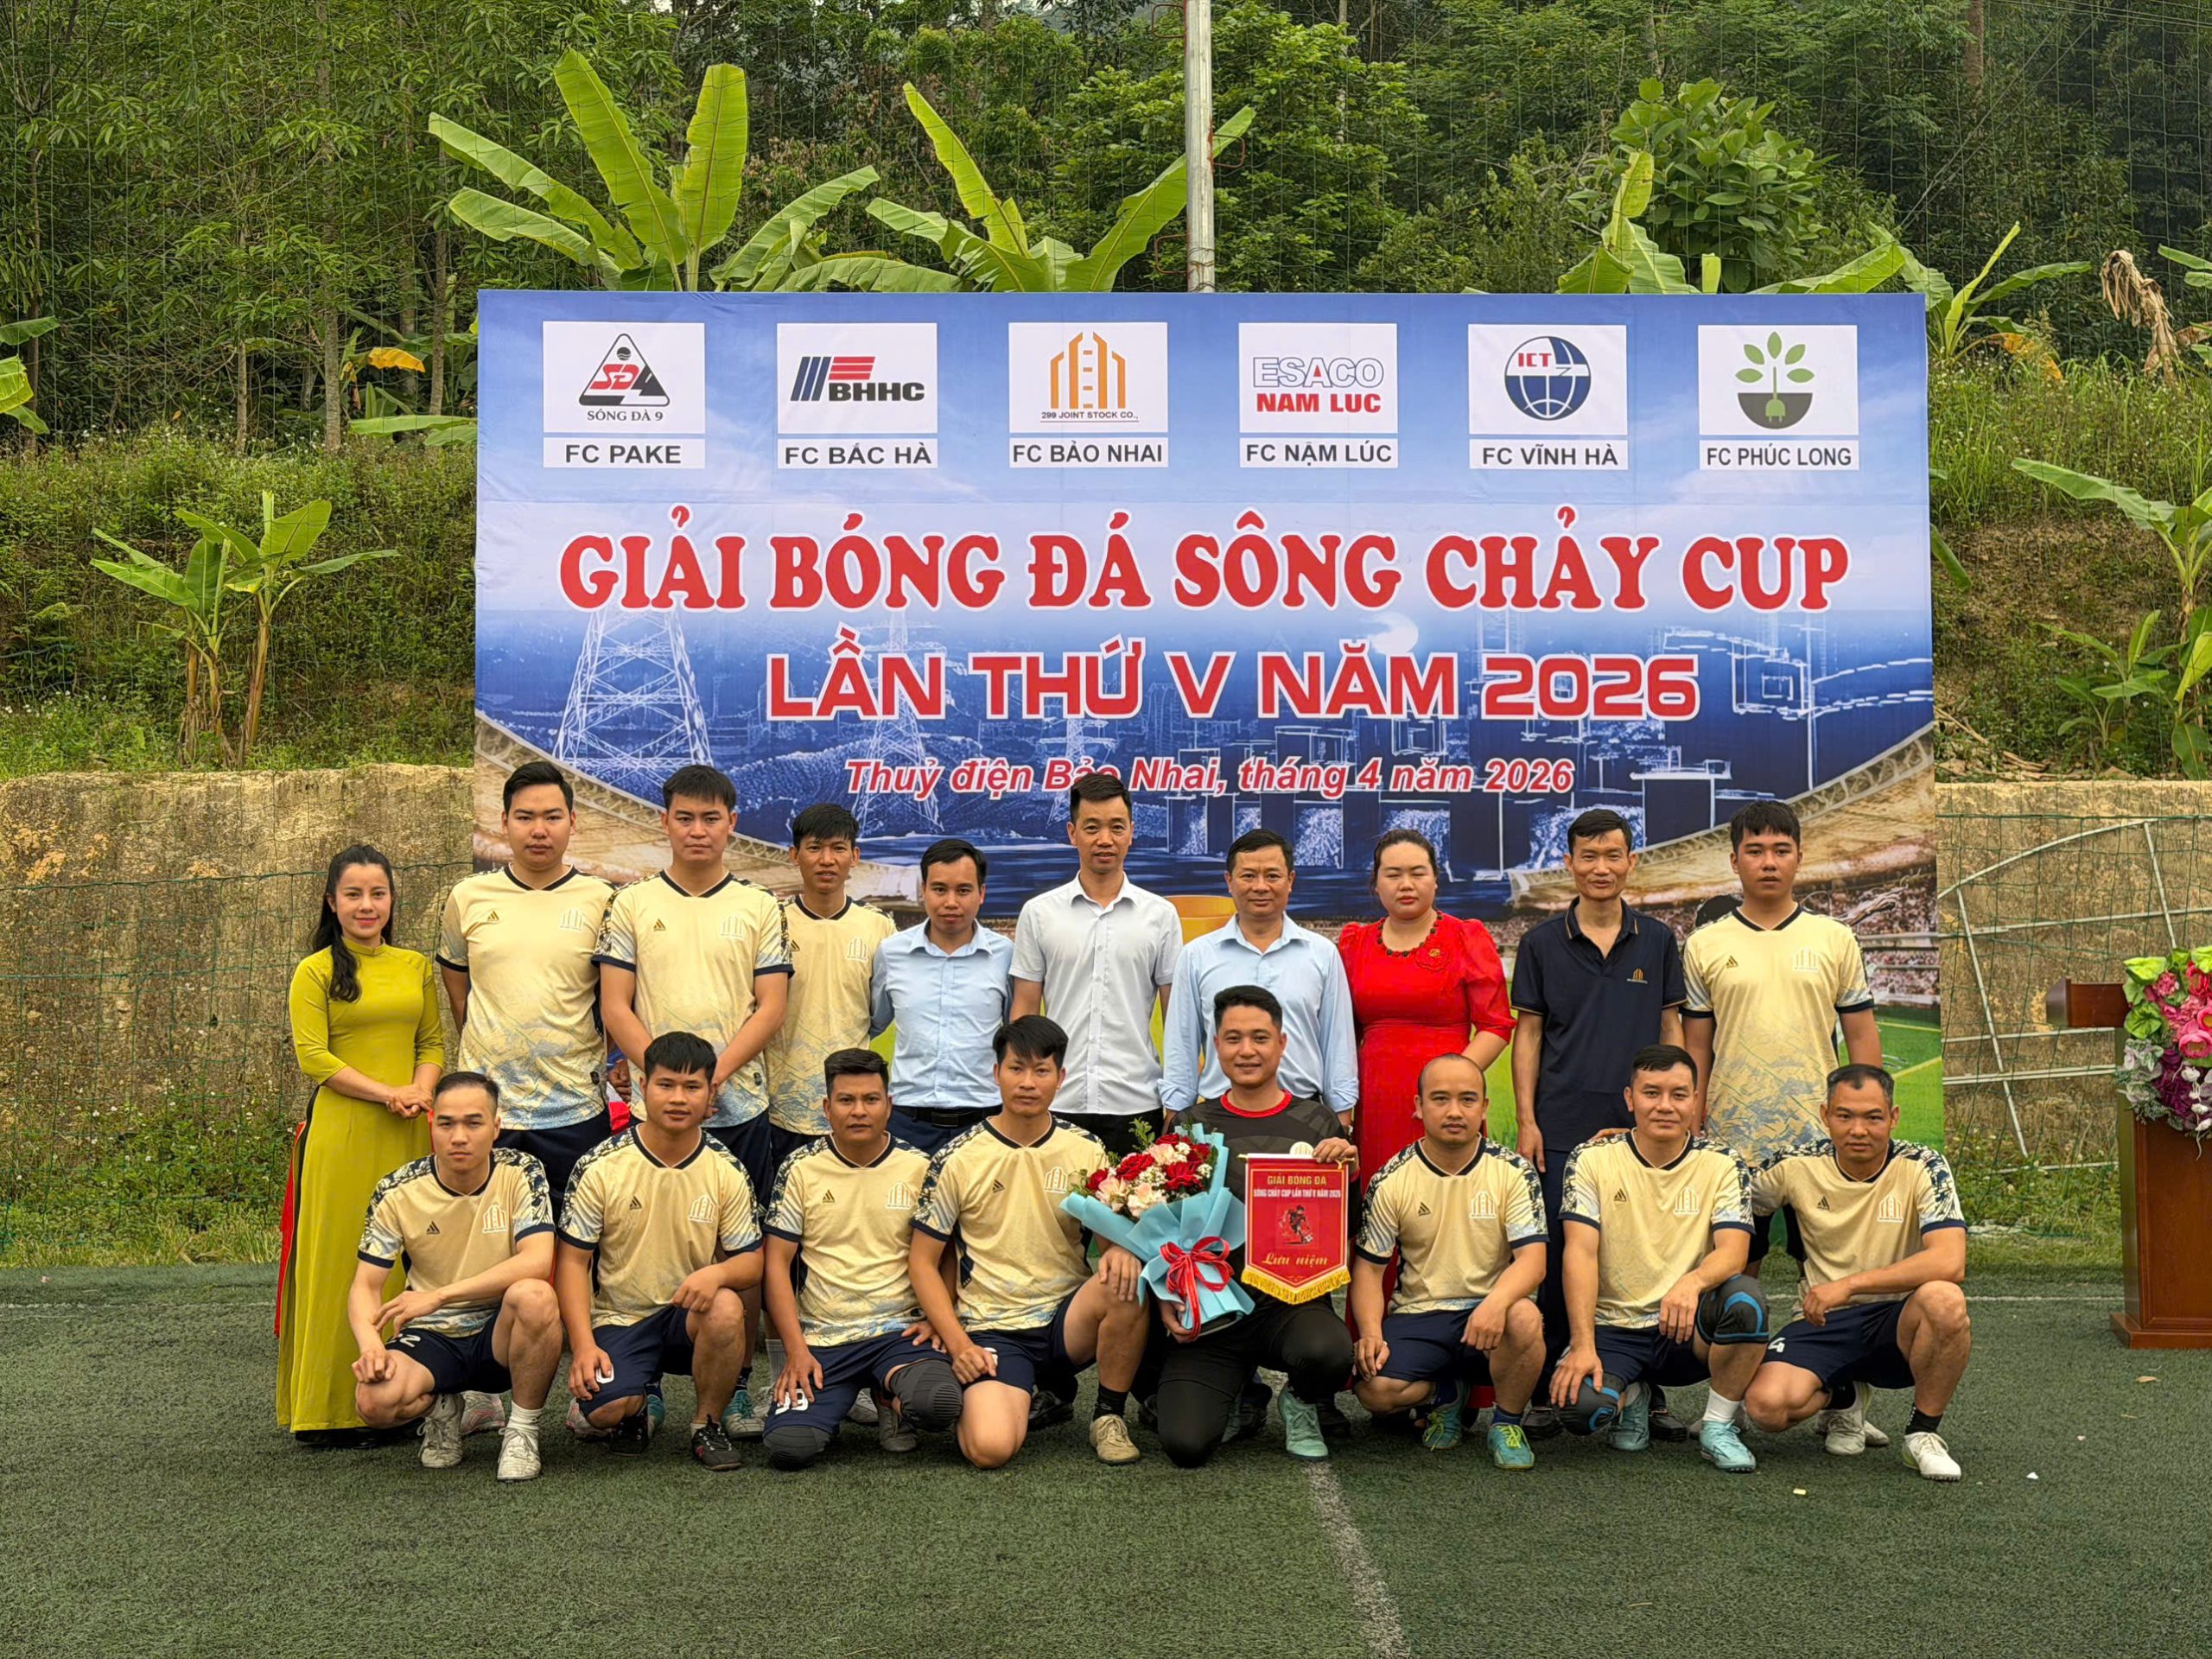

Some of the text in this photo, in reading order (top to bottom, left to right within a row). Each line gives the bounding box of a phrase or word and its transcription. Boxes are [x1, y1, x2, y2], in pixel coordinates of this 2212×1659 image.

[1518, 353, 1552, 367] ICT
[1253, 356, 1385, 389] ESACO
[829, 382, 925, 402] BHHC
[1256, 392, 1382, 414] NAM LUC
[654, 411, 664, 422] 9
[1041, 411, 1058, 420] 299
[1058, 411, 1085, 420] JOINT
[1087, 411, 1118, 420] STOCK
[565, 444, 682, 464] FC PAKE
[785, 447, 819, 465] FC
[894, 442, 932, 464] HÀ
[1013, 440, 1163, 463] FC BẢO NHAI
[1246, 440, 1393, 467] FC NẬM LÚC
[1482, 443, 1619, 467] FC VĨNH HÀ
[1707, 442, 1852, 467] FC PHÚC LONG
[559, 505, 1849, 611] GIẢI BÓNG ĐÁ SÔNG CHẢY CUP
[769, 627, 1698, 718] LẦN THỨ V NĂM 2026
[848, 760, 940, 800] Thuỷ
[951, 760, 1033, 798] điện
[1131, 759, 1225, 797] Nhai,
[1240, 759, 1347, 798] tháng
[1358, 760, 1380, 790] 4
[1392, 759, 1472, 791] năm
[1485, 760, 1573, 792] 2026
